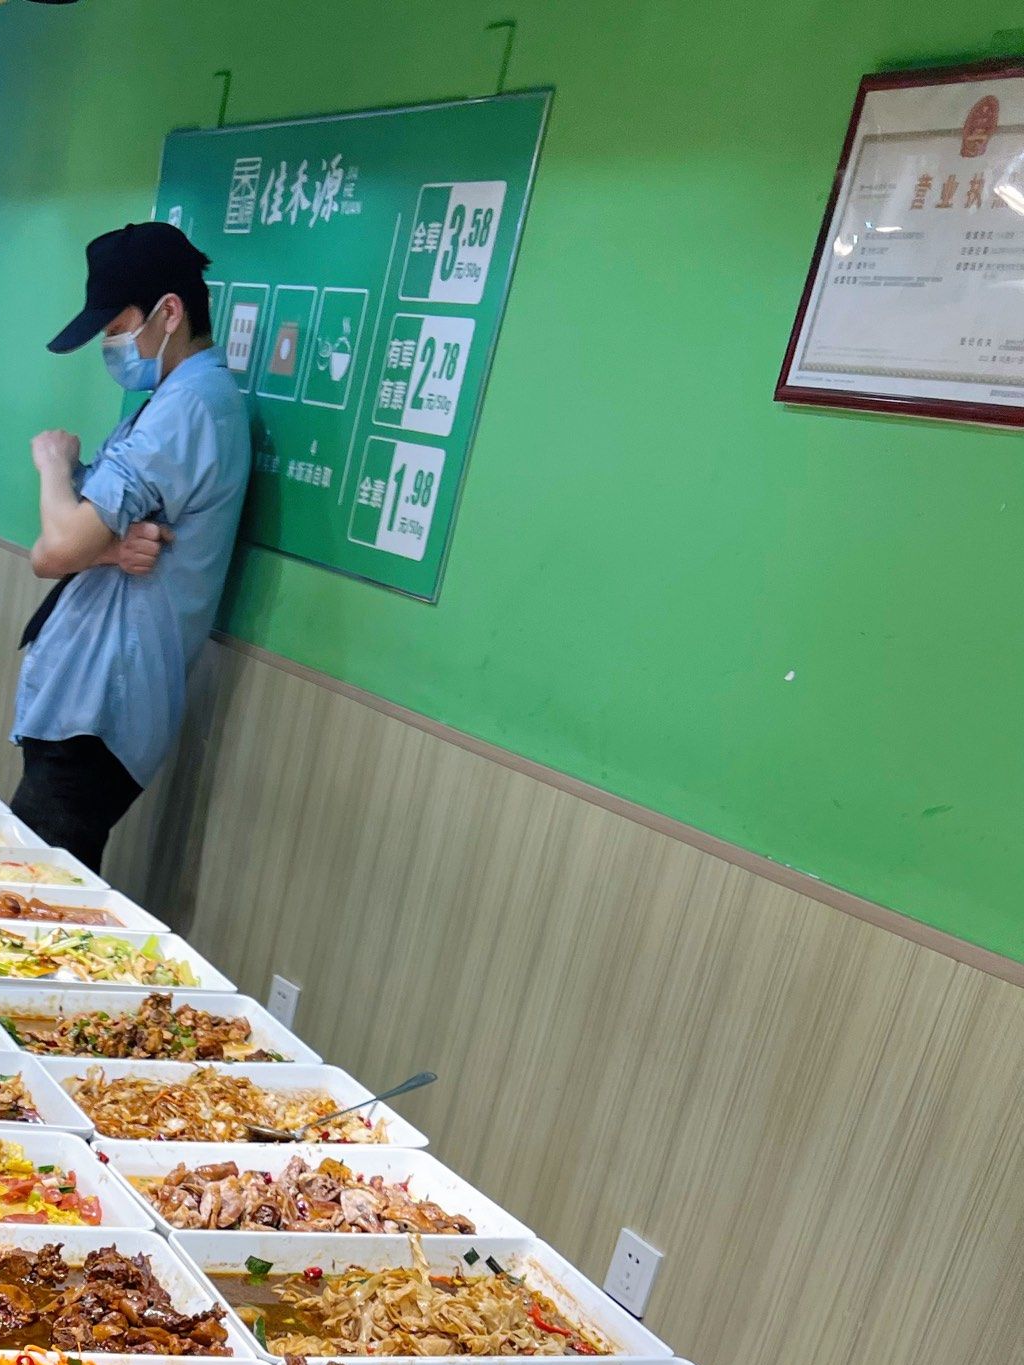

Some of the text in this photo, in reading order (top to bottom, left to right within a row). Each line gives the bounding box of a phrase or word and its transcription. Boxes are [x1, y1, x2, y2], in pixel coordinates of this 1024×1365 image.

[440, 204, 494, 281] 3.58
[411, 336, 460, 410] 2.78
[387, 463, 434, 532] 1.98
